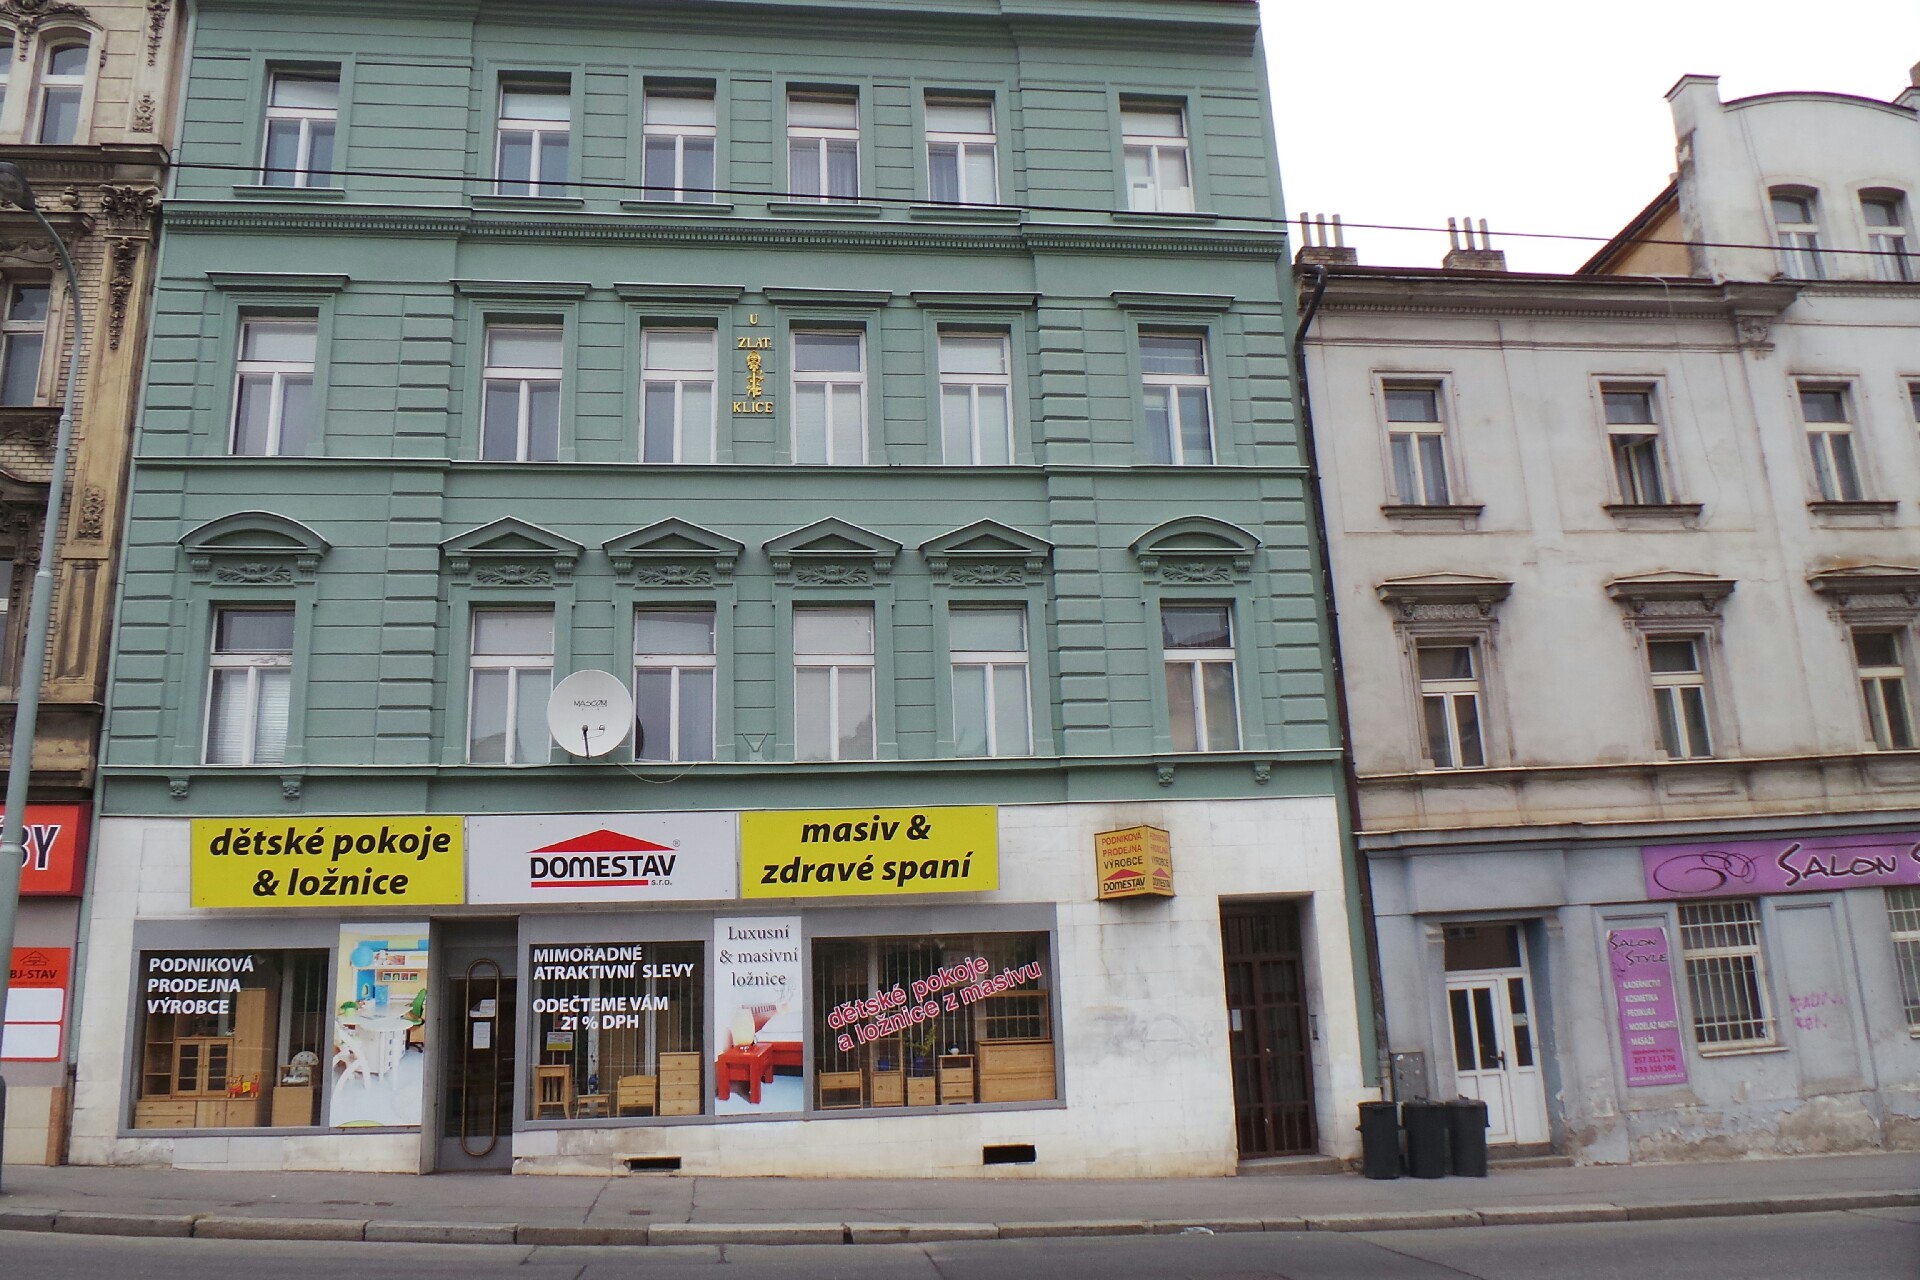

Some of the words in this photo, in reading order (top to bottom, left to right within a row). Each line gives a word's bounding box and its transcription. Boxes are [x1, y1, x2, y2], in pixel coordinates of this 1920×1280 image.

[749, 313, 759, 325] U
[800, 814, 900, 843] masiv
[906, 814, 932, 841] &
[209, 827, 325, 856] dětské
[330, 825, 451, 862] pokoje
[1102, 844, 1143, 857] PRODEJNA
[530, 854, 677, 879] DOMESTAV
[760, 854, 874, 884] zdravé
[881, 851, 974, 887] spaní
[1103, 855, 1144, 870] VÝROBCE
[1777, 842, 1897, 887] SALON
[252, 869, 280, 897] &
[287, 867, 409, 896] ložnice
[1103, 877, 1146, 891] DOMESTAV
[728, 924, 791, 940] Luxusní
[1609, 933, 1657, 950] SALON
[533, 944, 643, 963] MIMOŘADNÉ
[719, 949, 733, 964] &
[737, 946, 798, 963] masivní
[149, 955, 254, 973] PODNIKOVÁ
[533, 962, 636, 980] ATRAKTIVNÍ
[642, 963, 695, 979] SLEVY
[147, 978, 242, 993] PRODEJNA
[732, 971, 787, 987] ložnice
[828, 983, 907, 1029] dětské
[911, 956, 989, 1002] pokoje
[147, 996, 230, 1014] VÝROBCE
[532, 995, 627, 1013] ODEČTEME
[629, 993, 668, 1011] VÁM
[838, 1032, 855, 1051] a
[855, 999, 940, 1045] ložnice
[943, 992, 960, 1012] z
[959, 961, 1043, 1005] masivu
[560, 1016, 577, 1030] 21
[581, 1015, 599, 1030] %
[602, 1014, 639, 1030] DPH
